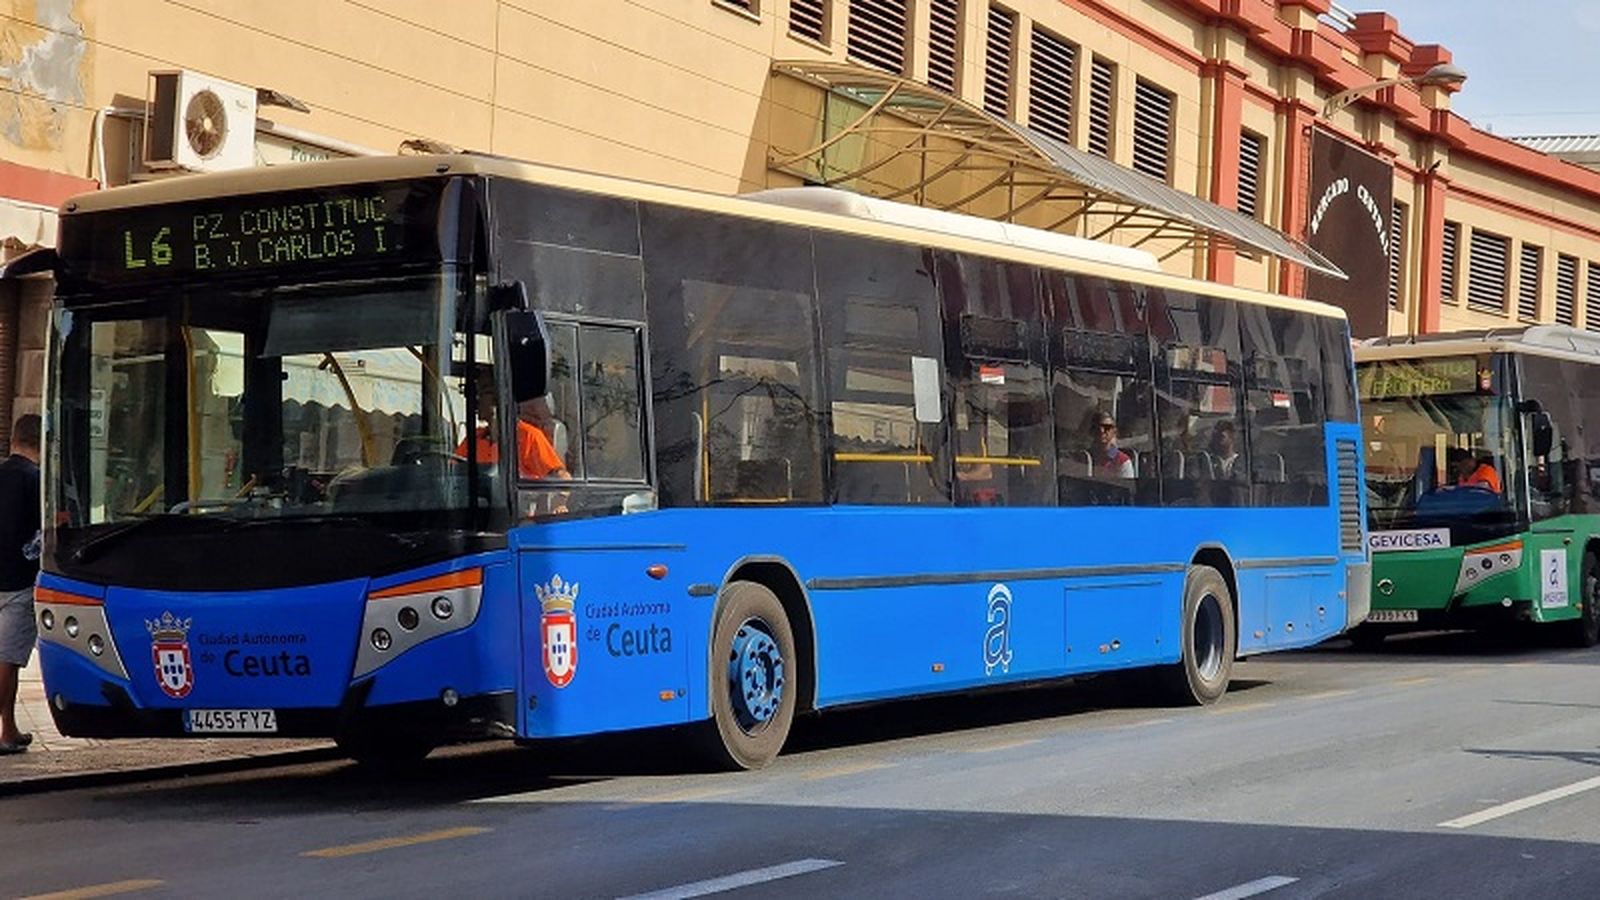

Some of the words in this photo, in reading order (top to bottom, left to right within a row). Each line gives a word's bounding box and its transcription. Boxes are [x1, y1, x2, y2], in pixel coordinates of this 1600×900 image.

[192, 213, 230, 240] PZ.
[240, 197, 386, 235] CONSTITUC
[1311, 177, 1348, 234] MERCADO
[1357, 184, 1389, 256] CENTRAL
[124, 227, 173, 269] L6
[194, 243, 216, 269] B.
[226, 240, 249, 266] J.
[257, 229, 356, 263] CARLOS
[586, 603, 619, 618] Ciudad
[199, 633, 238, 645] Ciudad
[587, 625, 600, 641] de
[607, 623, 672, 657] Ceuta
[223, 649, 311, 677] Ceuta
